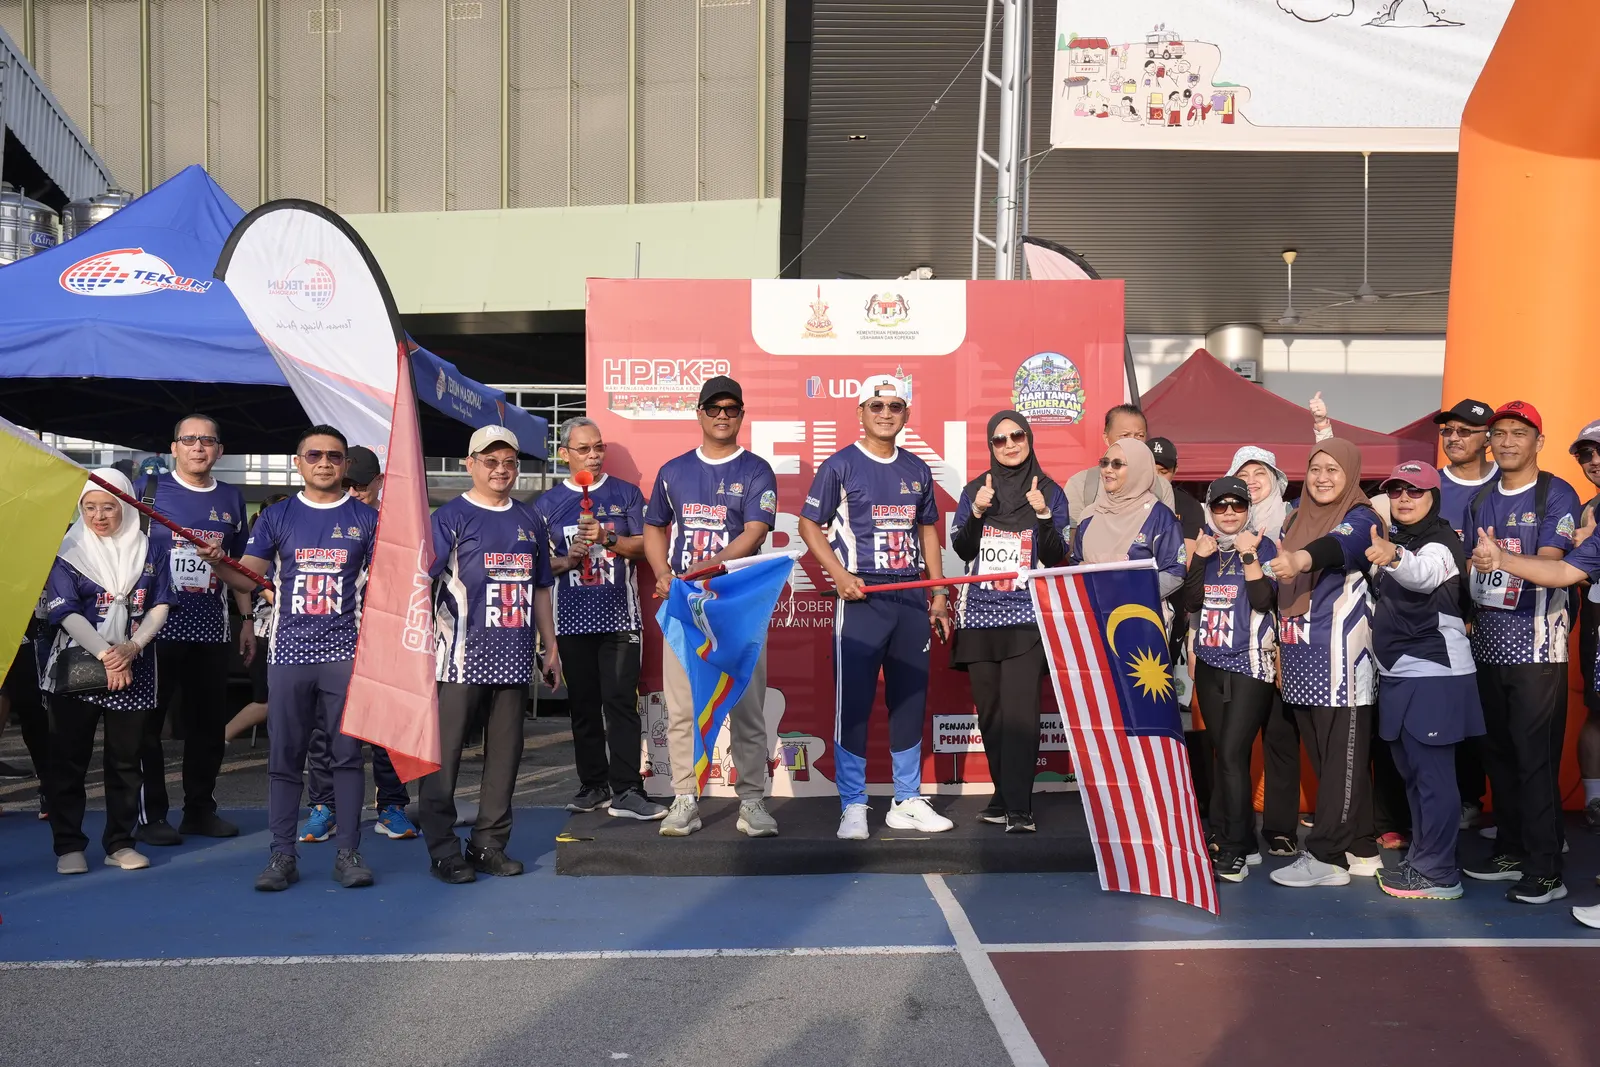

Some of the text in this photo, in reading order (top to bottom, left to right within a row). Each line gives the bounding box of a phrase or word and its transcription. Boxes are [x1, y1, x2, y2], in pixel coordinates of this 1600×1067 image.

[133, 269, 213, 290] TEKUN
[141, 280, 206, 293] NASIONAL
[603, 358, 702, 387] HPPK
[828, 379, 862, 398] UD
[1020, 392, 1078, 402] HARI TANPA
[1015, 400, 1081, 412] KENDERAAN
[682, 503, 718, 517] HPPK
[872, 504, 907, 519] HPPK
[683, 530, 730, 552] FUN
[873, 531, 917, 551] FUN
[294, 548, 336, 563] HPPK
[484, 552, 524, 568] HPPK
[874, 551, 917, 570] RUN
[174, 558, 207, 574] 1134
[292, 575, 344, 596] FUN
[486, 583, 533, 606] FUN
[1204, 584, 1227, 597] PPK
[291, 595, 343, 615] RUN
[485, 606, 532, 628] RUN
[770, 617, 809, 628] TARAN
[1200, 609, 1235, 630] FUN
[1198, 628, 1234, 648] RUN
[1280, 621, 1311, 645] UN
[939, 722, 976, 730] PENJAJA
[1040, 721, 1057, 729] ECIL
[939, 734, 983, 745] PEMANG
